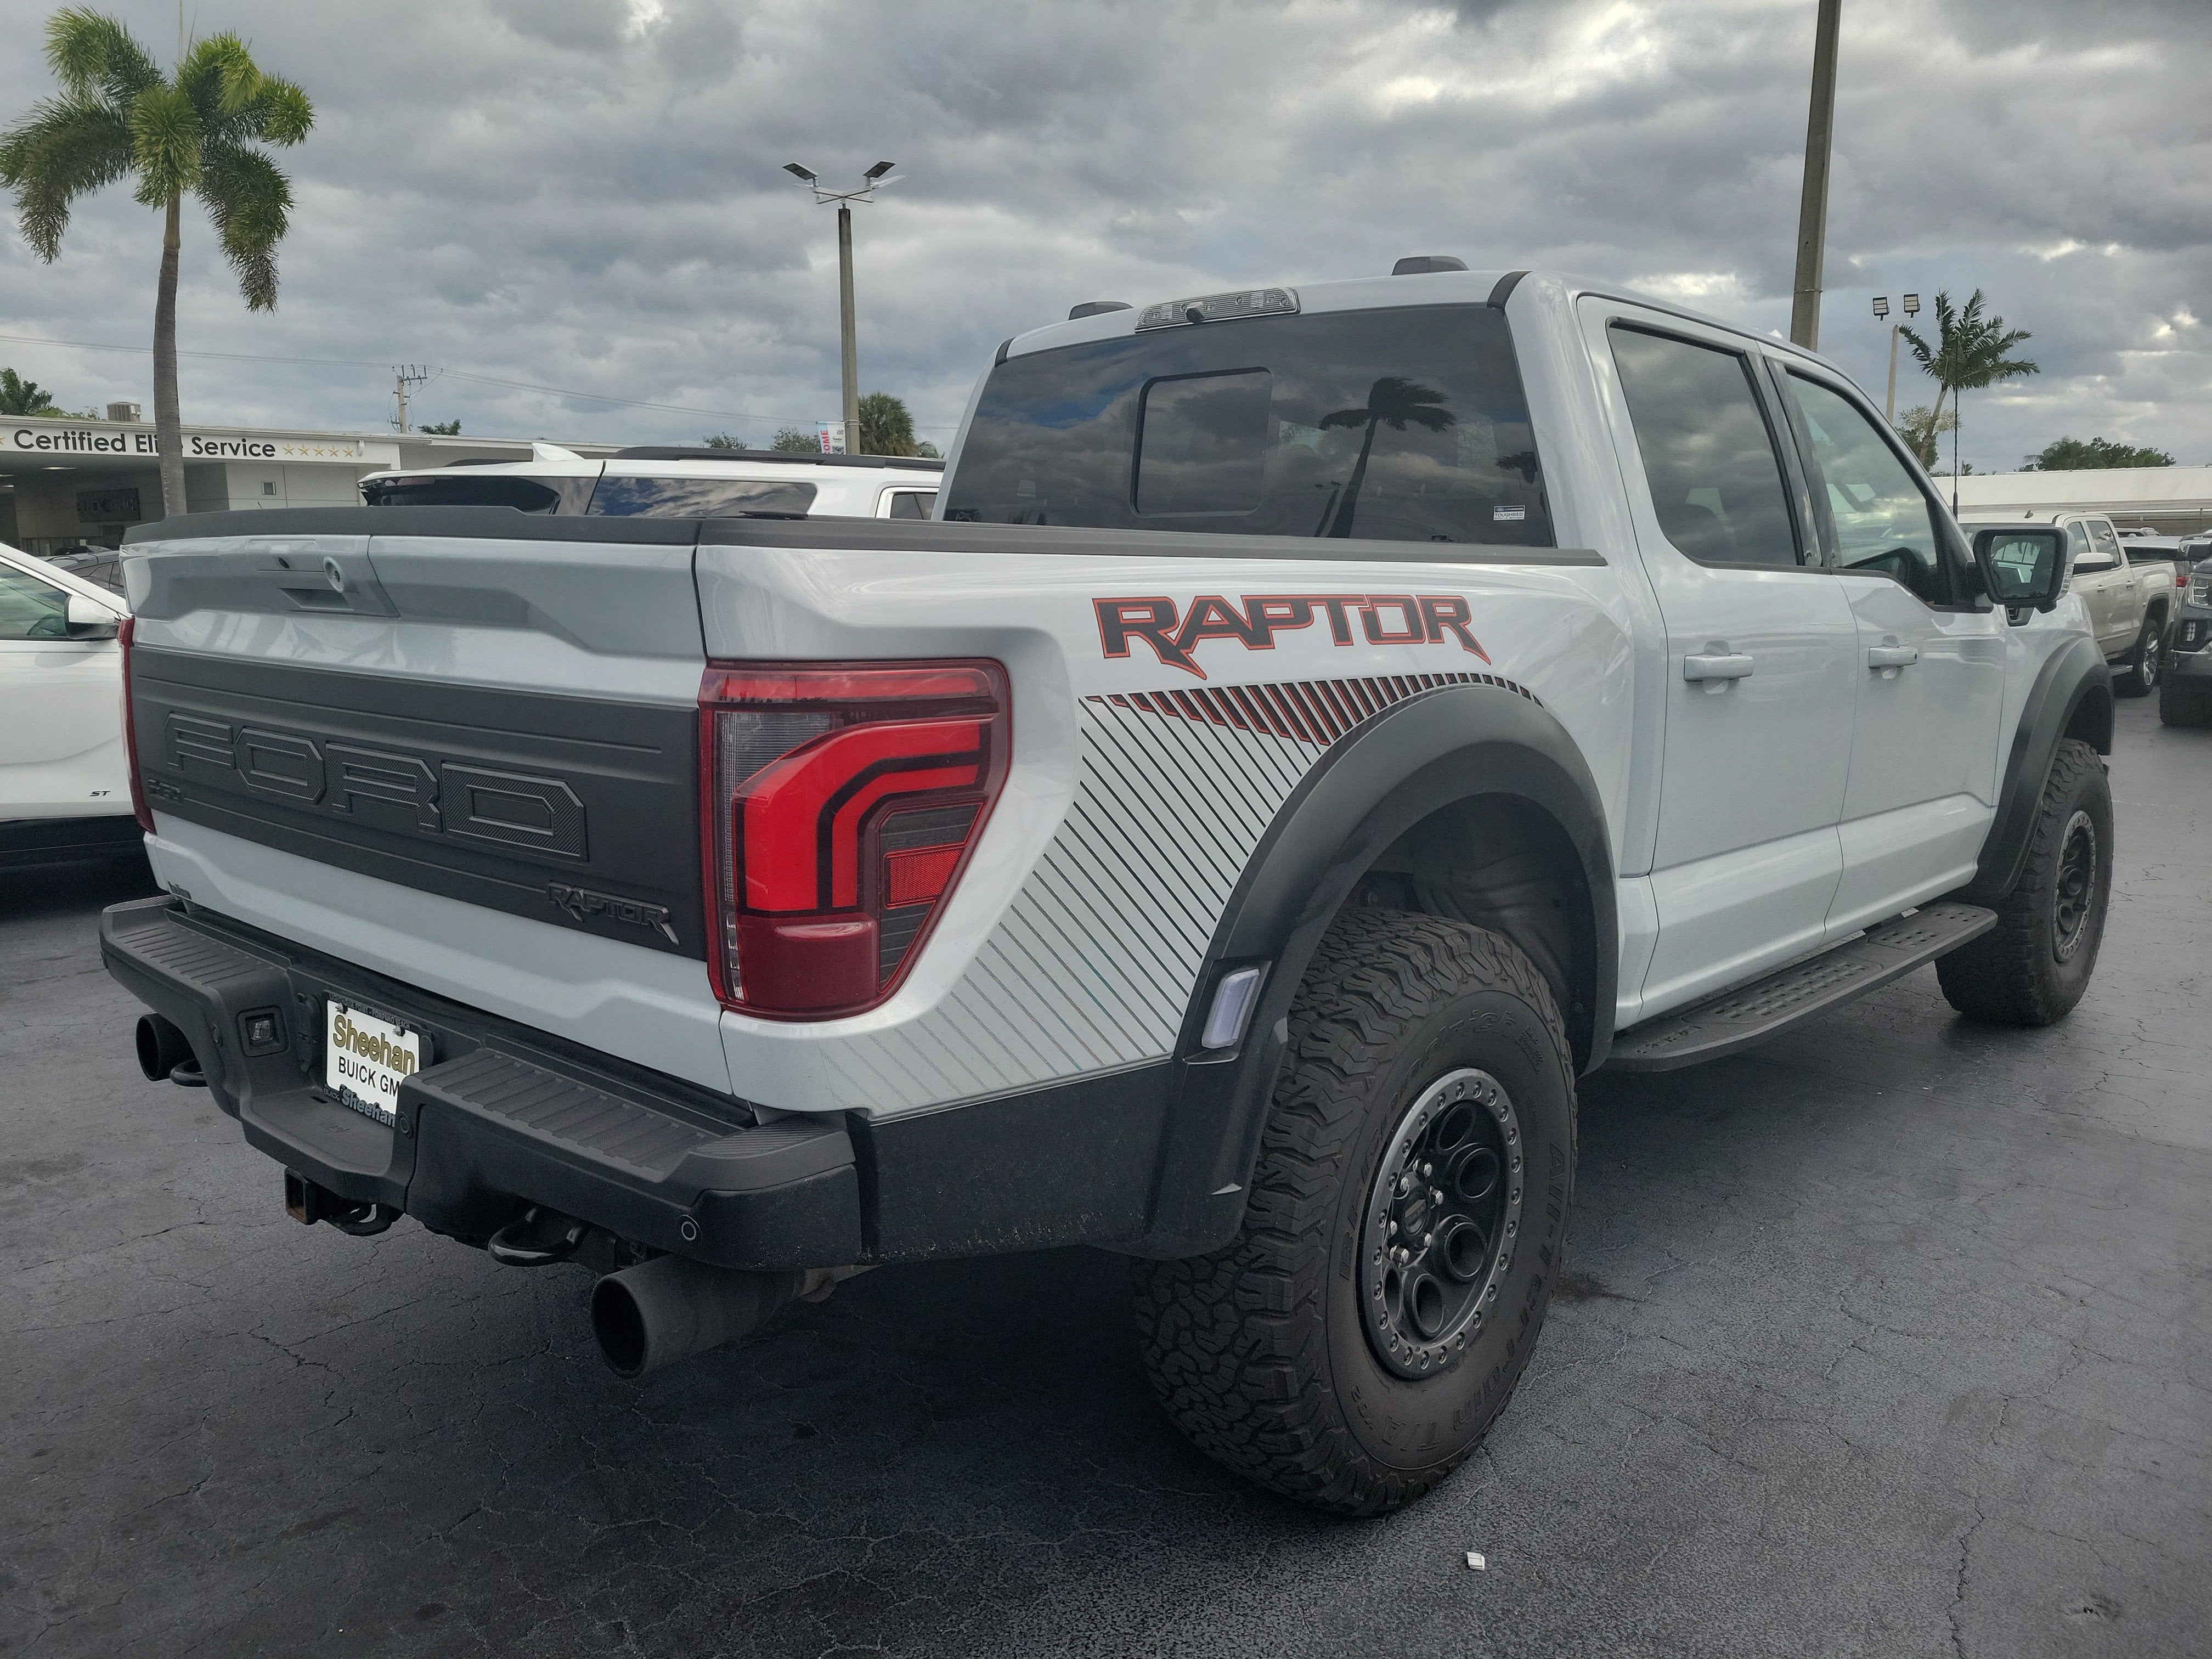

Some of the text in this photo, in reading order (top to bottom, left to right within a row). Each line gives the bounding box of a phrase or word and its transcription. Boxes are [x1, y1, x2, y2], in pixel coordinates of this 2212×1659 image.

[14, 429, 276, 457] Certified Eli Service
[821, 430, 831, 454] OME
[1092, 594, 1491, 680] RAPTOR
[164, 712, 589, 862] FORD
[548, 880, 680, 946] RAPTOR
[333, 1014, 415, 1076] Sheehan
[338, 1056, 376, 1088] BUICK
[341, 1088, 396, 1128] Sheehan
